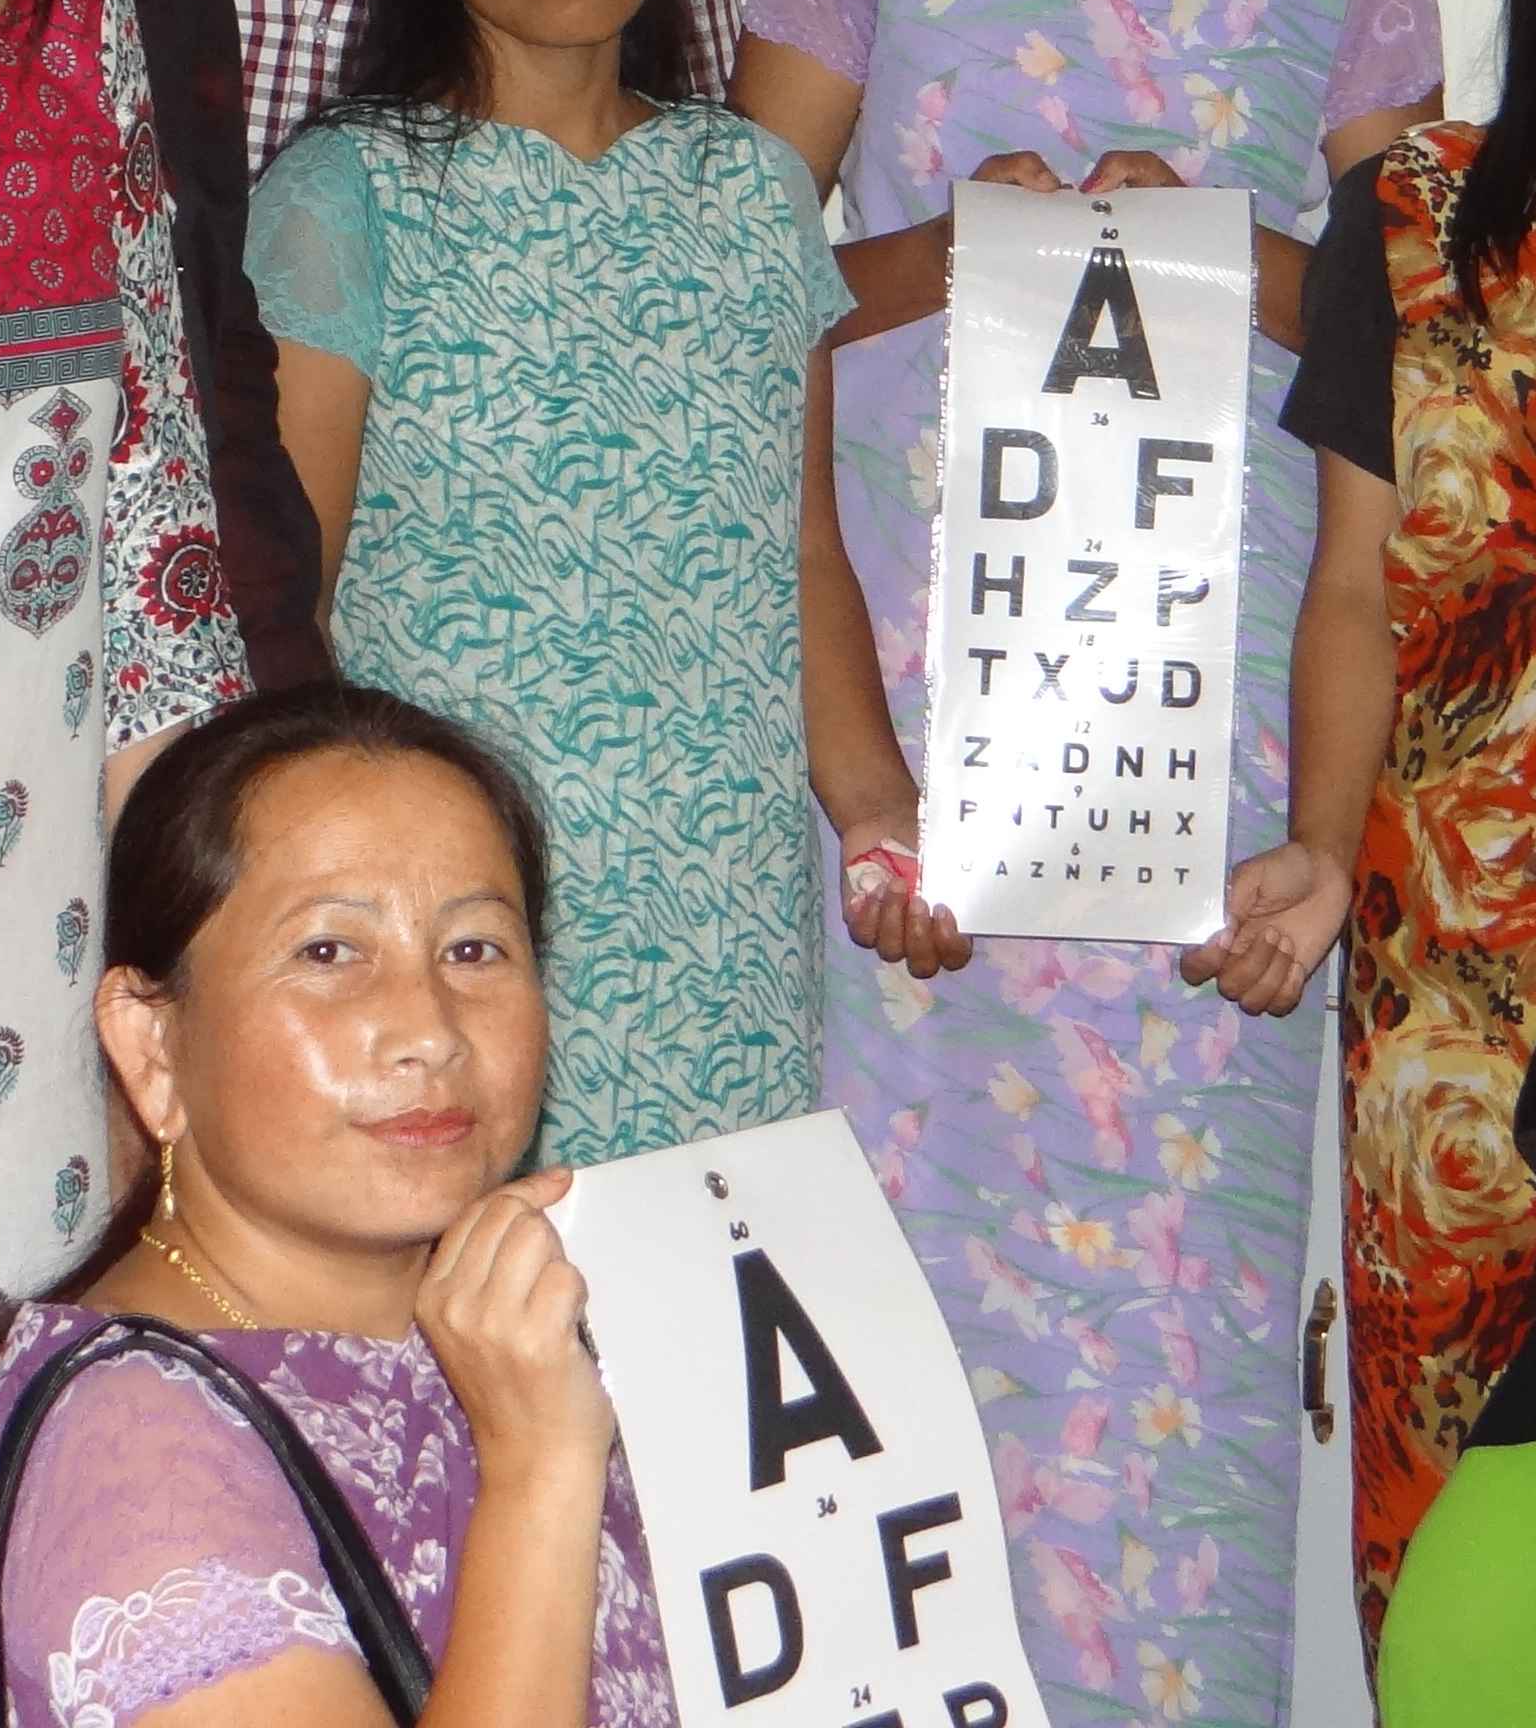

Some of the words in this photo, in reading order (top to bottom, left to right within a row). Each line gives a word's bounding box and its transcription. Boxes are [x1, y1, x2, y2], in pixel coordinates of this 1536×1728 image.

[1100, 227, 1119, 241] 60
[1040, 246, 1162, 401] A
[1090, 412, 1110, 427] 36
[980, 426, 1059, 521] D
[1134, 437, 1214, 530] F
[1084, 538, 1103, 553] 24
[971, 552, 1025, 618] H
[1064, 559, 1120, 623] Z
[1156, 564, 1210, 627] P
[1078, 633, 1095, 647] 18
[1073, 784, 1083, 798] 9
[1070, 843, 1080, 856] 6
[729, 1220, 750, 1241] 60
[732, 1247, 885, 1493] A
[815, 1496, 839, 1518] 36
[699, 1552, 805, 1710] D
[876, 1490, 964, 1651] F
[849, 1683, 873, 1709] 24
